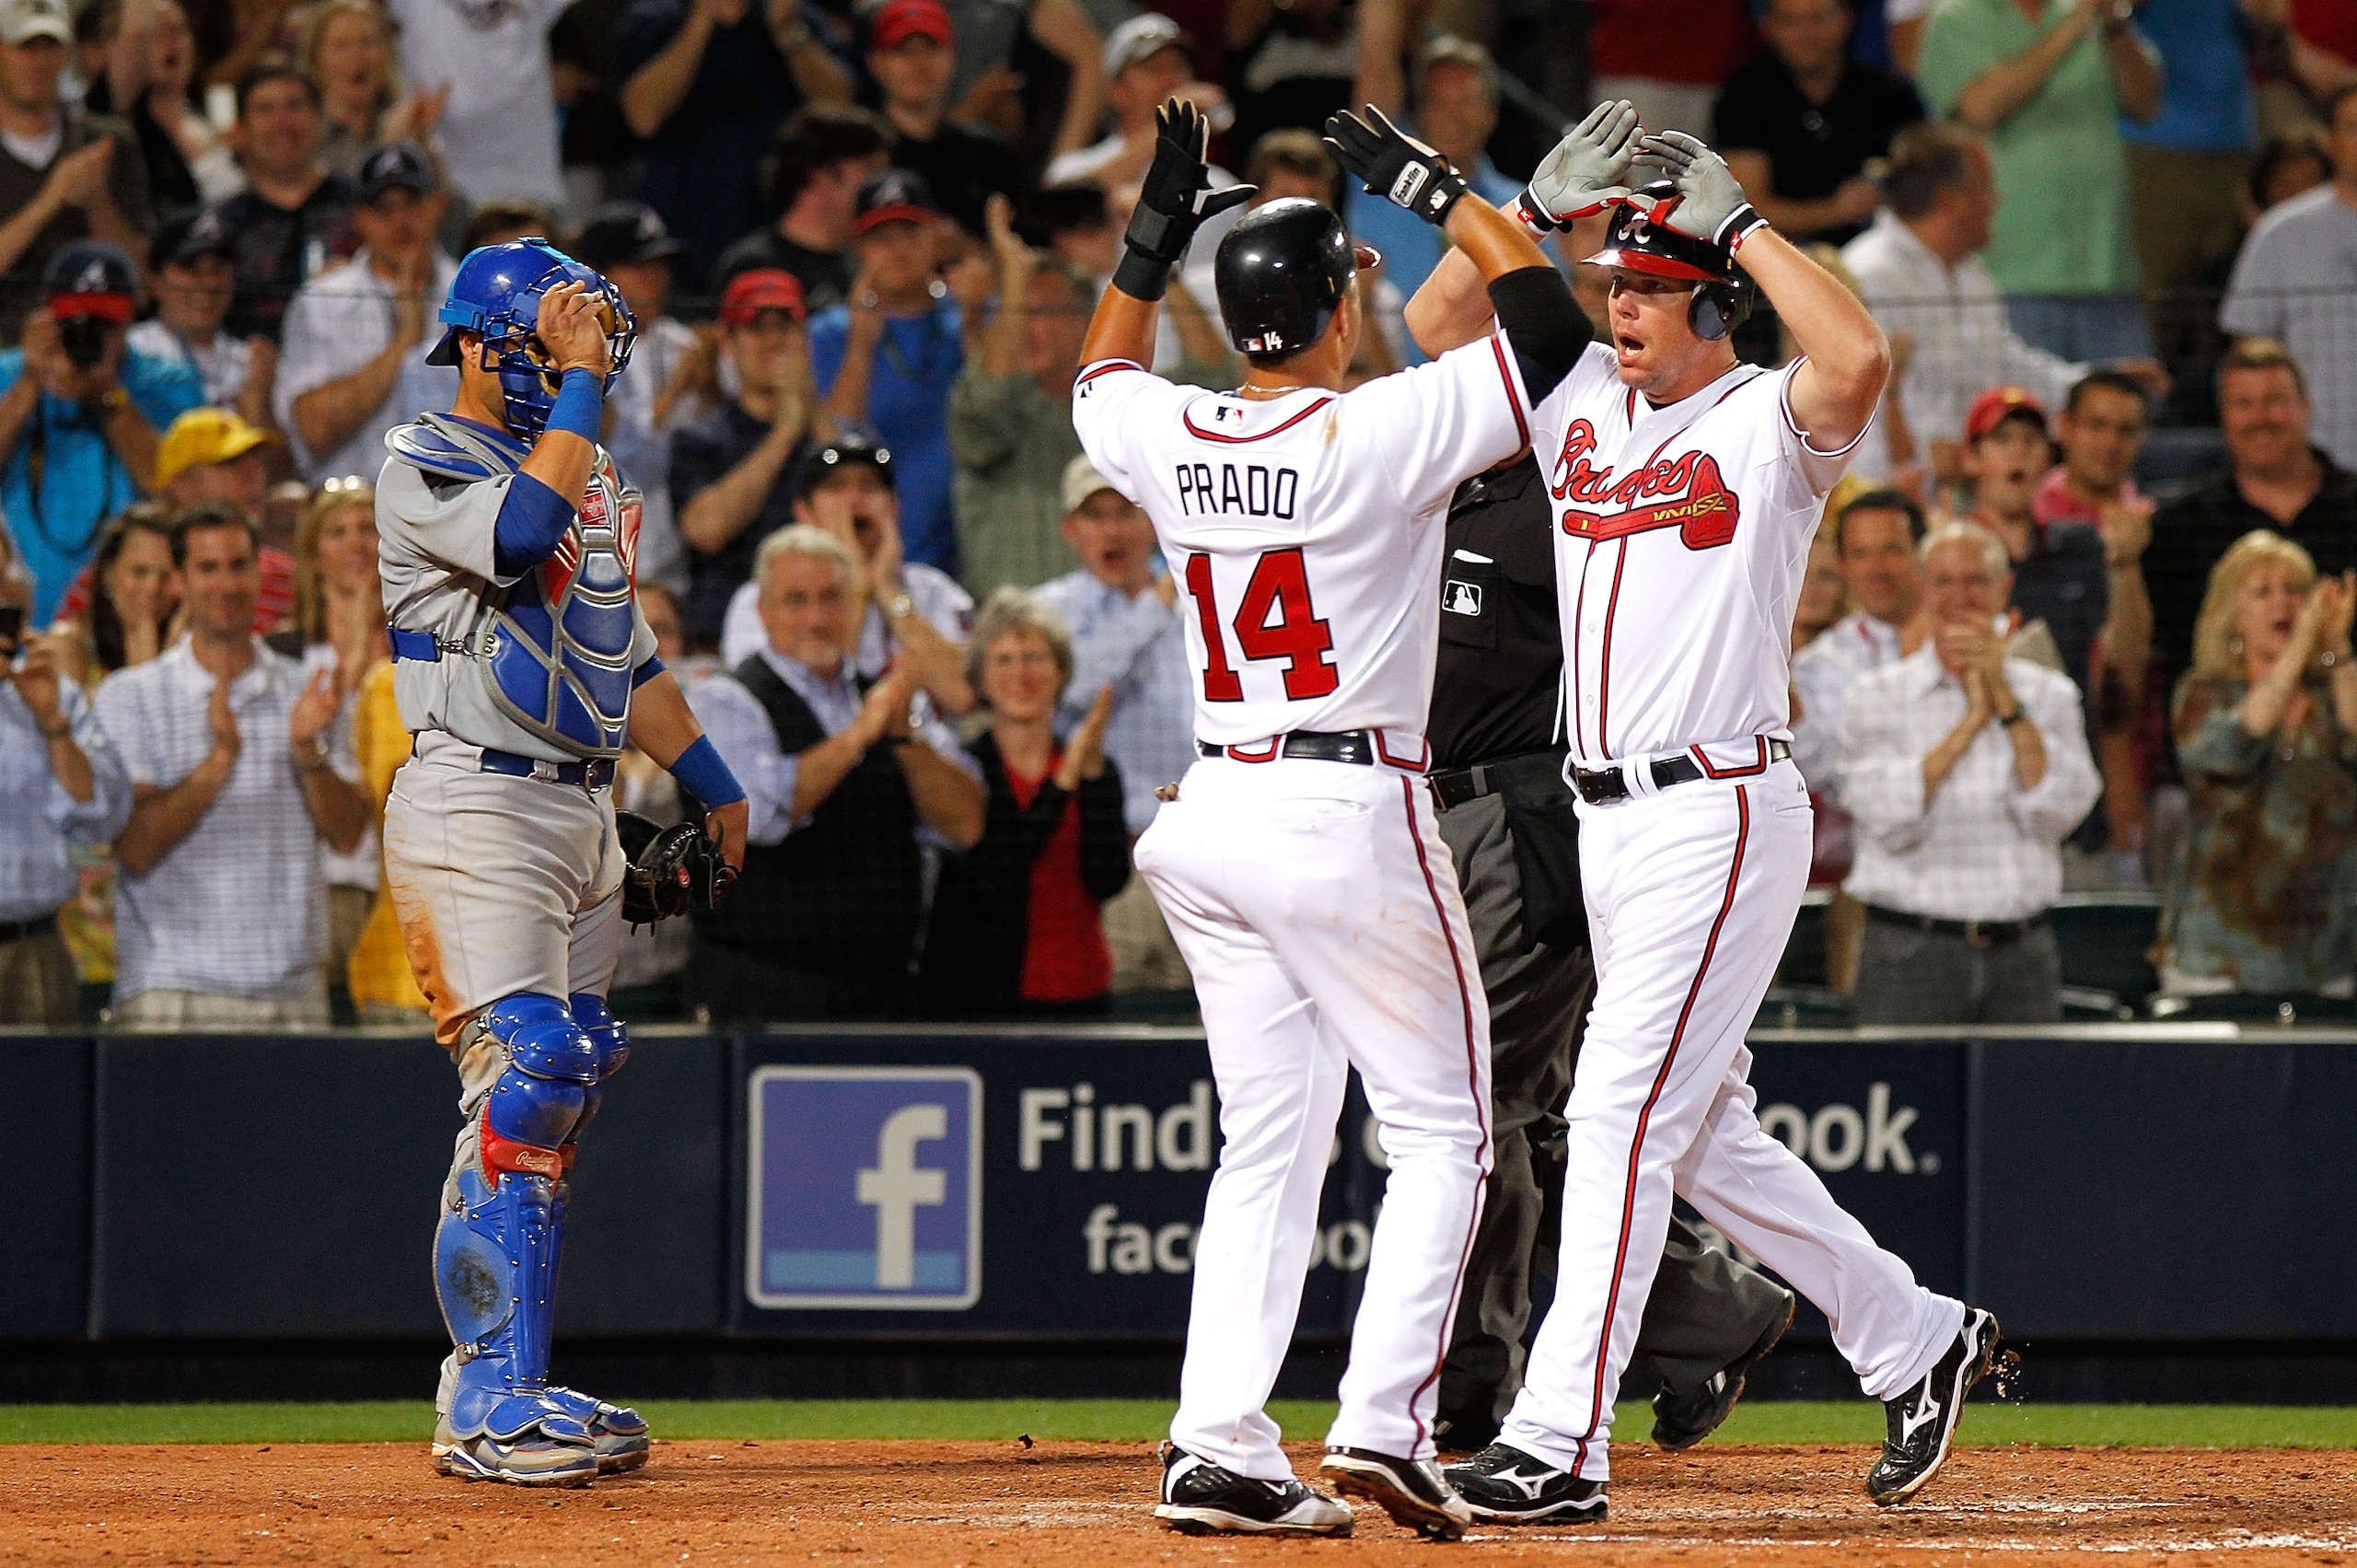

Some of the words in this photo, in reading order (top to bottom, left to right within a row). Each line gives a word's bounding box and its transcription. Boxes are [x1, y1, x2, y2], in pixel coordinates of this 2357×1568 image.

[1263, 331, 1283, 352] 14
[1176, 463, 1299, 520] PRADO
[1551, 418, 1702, 505] Braves
[1185, 546, 1341, 703] 14
[1018, 1080, 1213, 1173] Find
